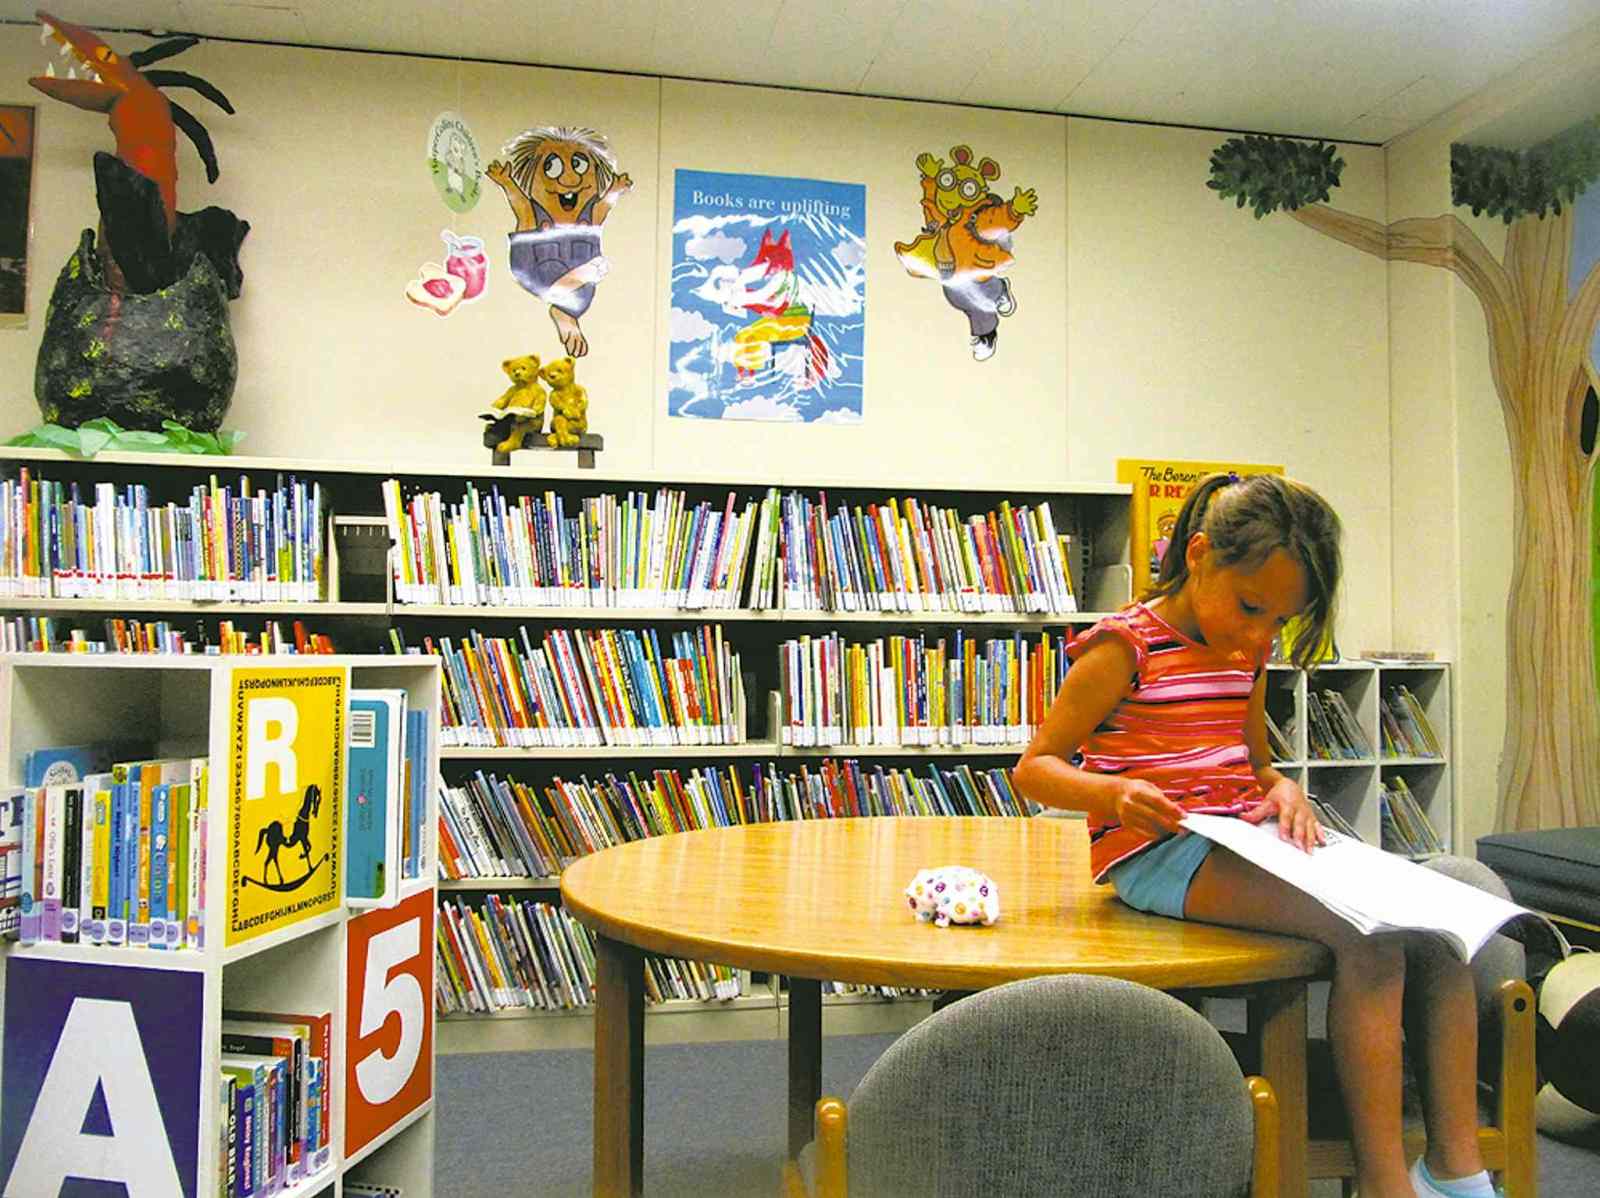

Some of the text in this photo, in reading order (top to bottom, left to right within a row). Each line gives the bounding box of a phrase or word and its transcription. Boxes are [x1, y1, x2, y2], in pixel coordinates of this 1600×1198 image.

[692, 190, 851, 218] Books are uplifting
[1140, 466, 1161, 481] The
[246, 696, 299, 801] R
[355, 916, 425, 1106] 5
[2, 997, 186, 1198] A
[228, 1115, 237, 1143] OLD
[228, 1147, 237, 1185] BEAR
